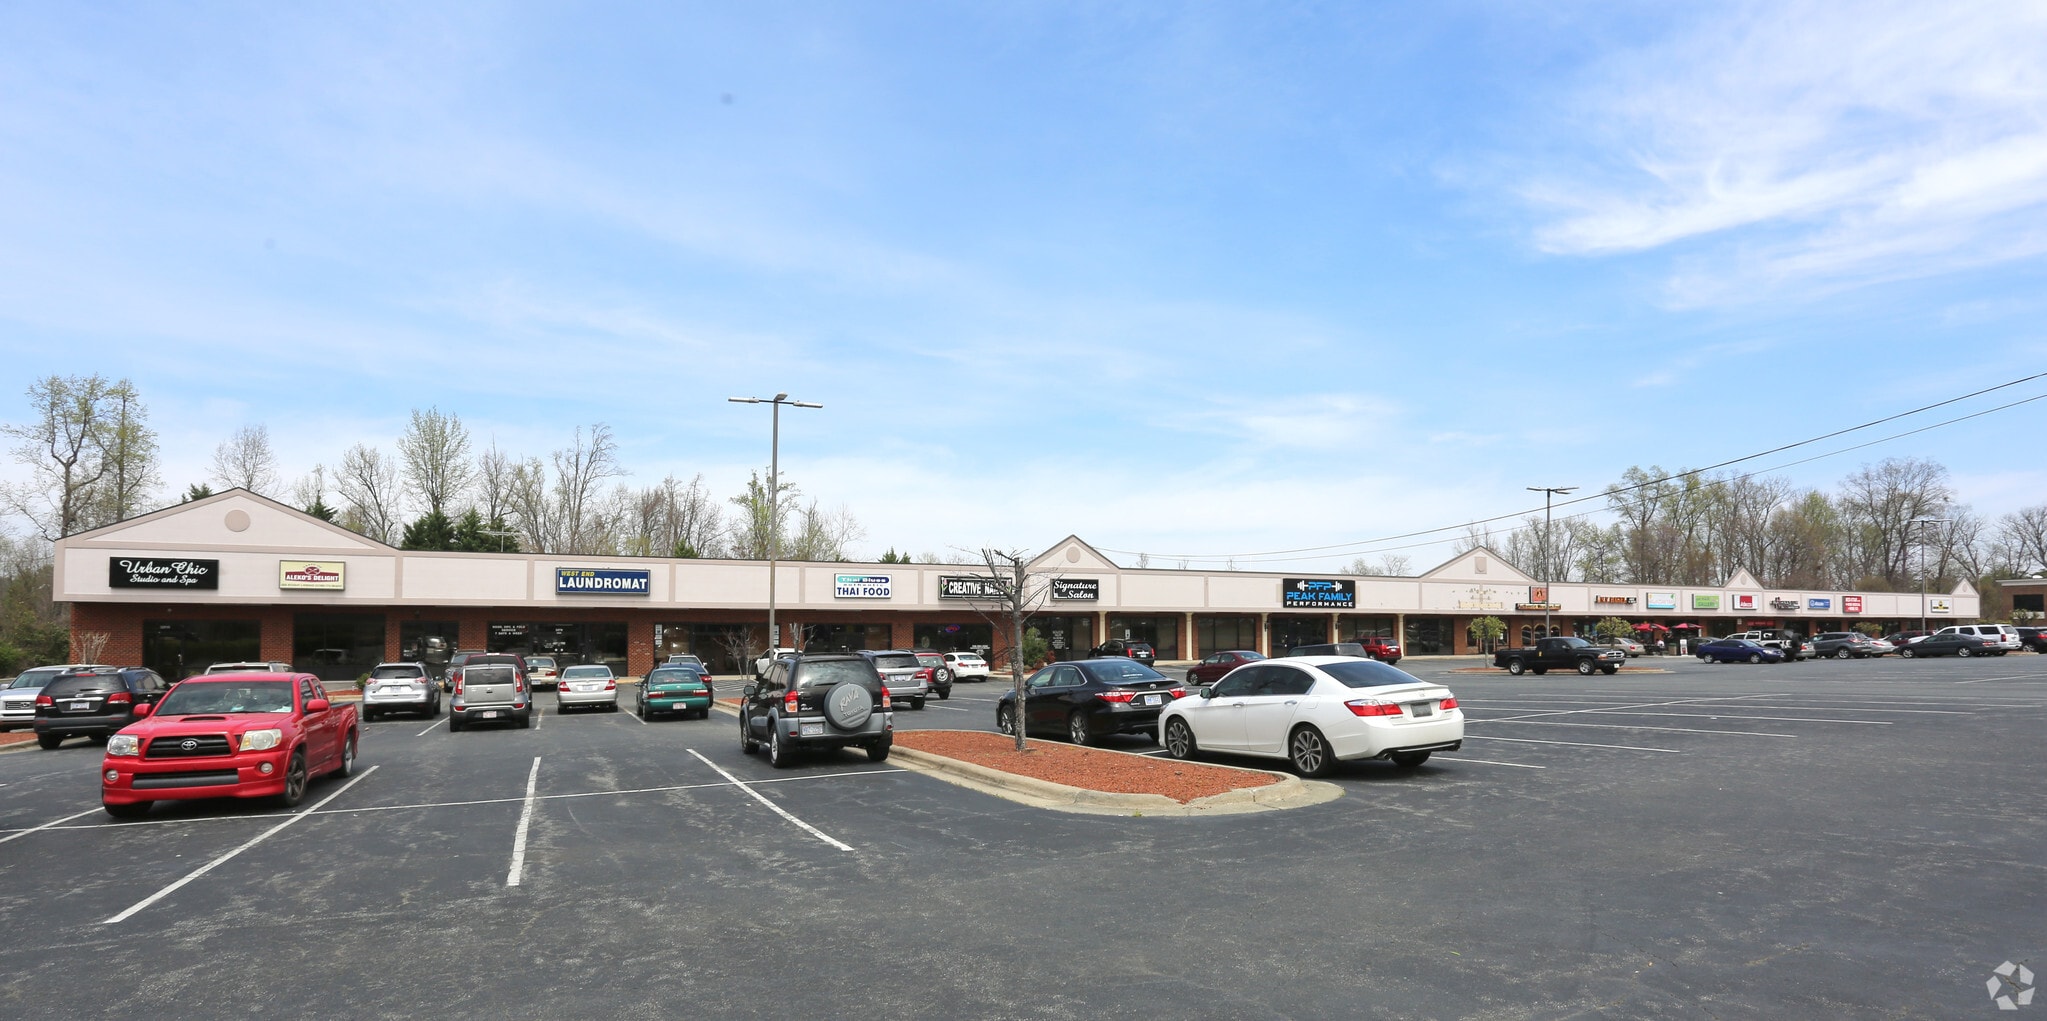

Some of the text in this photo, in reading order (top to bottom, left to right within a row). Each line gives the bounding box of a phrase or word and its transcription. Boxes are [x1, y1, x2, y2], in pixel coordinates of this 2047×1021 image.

[120, 560, 208, 575] Urban Chic
[129, 574, 199, 586] Studio and Spa
[560, 578, 647, 589] LAUNDROMAT
[837, 587, 890, 596] THAI FOOD
[948, 581, 981, 595] CREATIVE
[1053, 580, 1097, 593] Signature
[1067, 590, 1095, 599] Salon
[1287, 592, 1352, 601] PEAK FAMILY
[843, 706, 865, 717] TOYOTA
